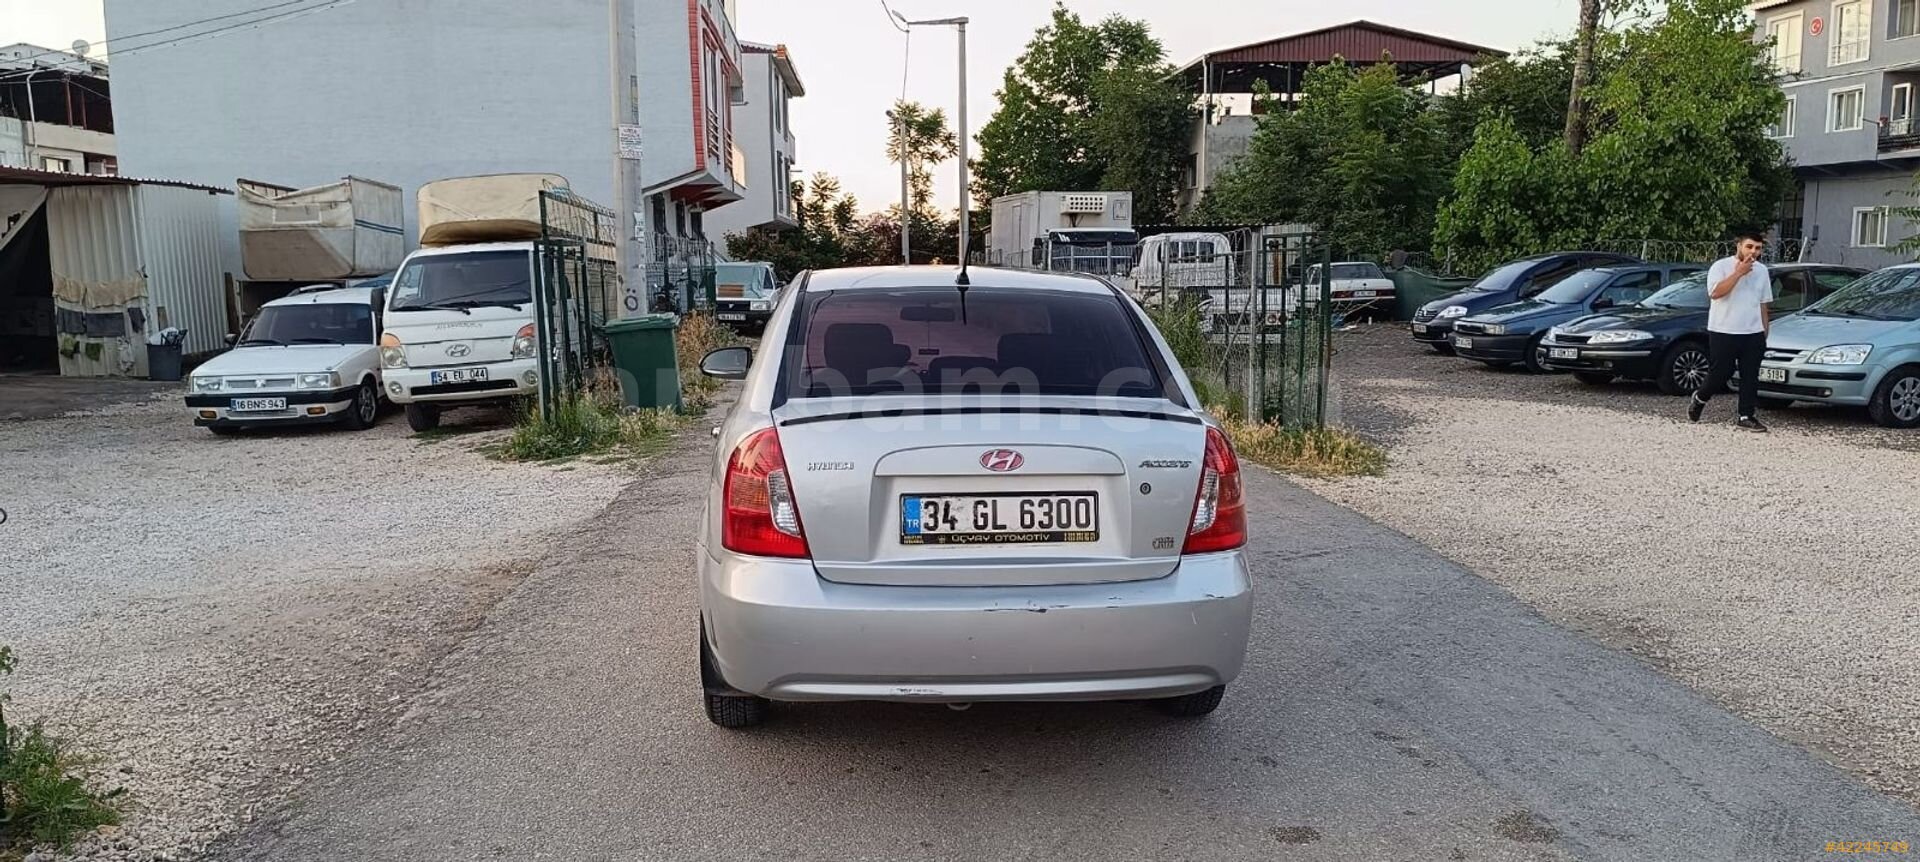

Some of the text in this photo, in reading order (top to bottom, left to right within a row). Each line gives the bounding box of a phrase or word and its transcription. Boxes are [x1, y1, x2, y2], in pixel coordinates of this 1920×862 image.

[236, 399, 285, 409] 16 BNS 943
[923, 498, 1092, 531] 34 GL 6300
[906, 519, 920, 529] TR
